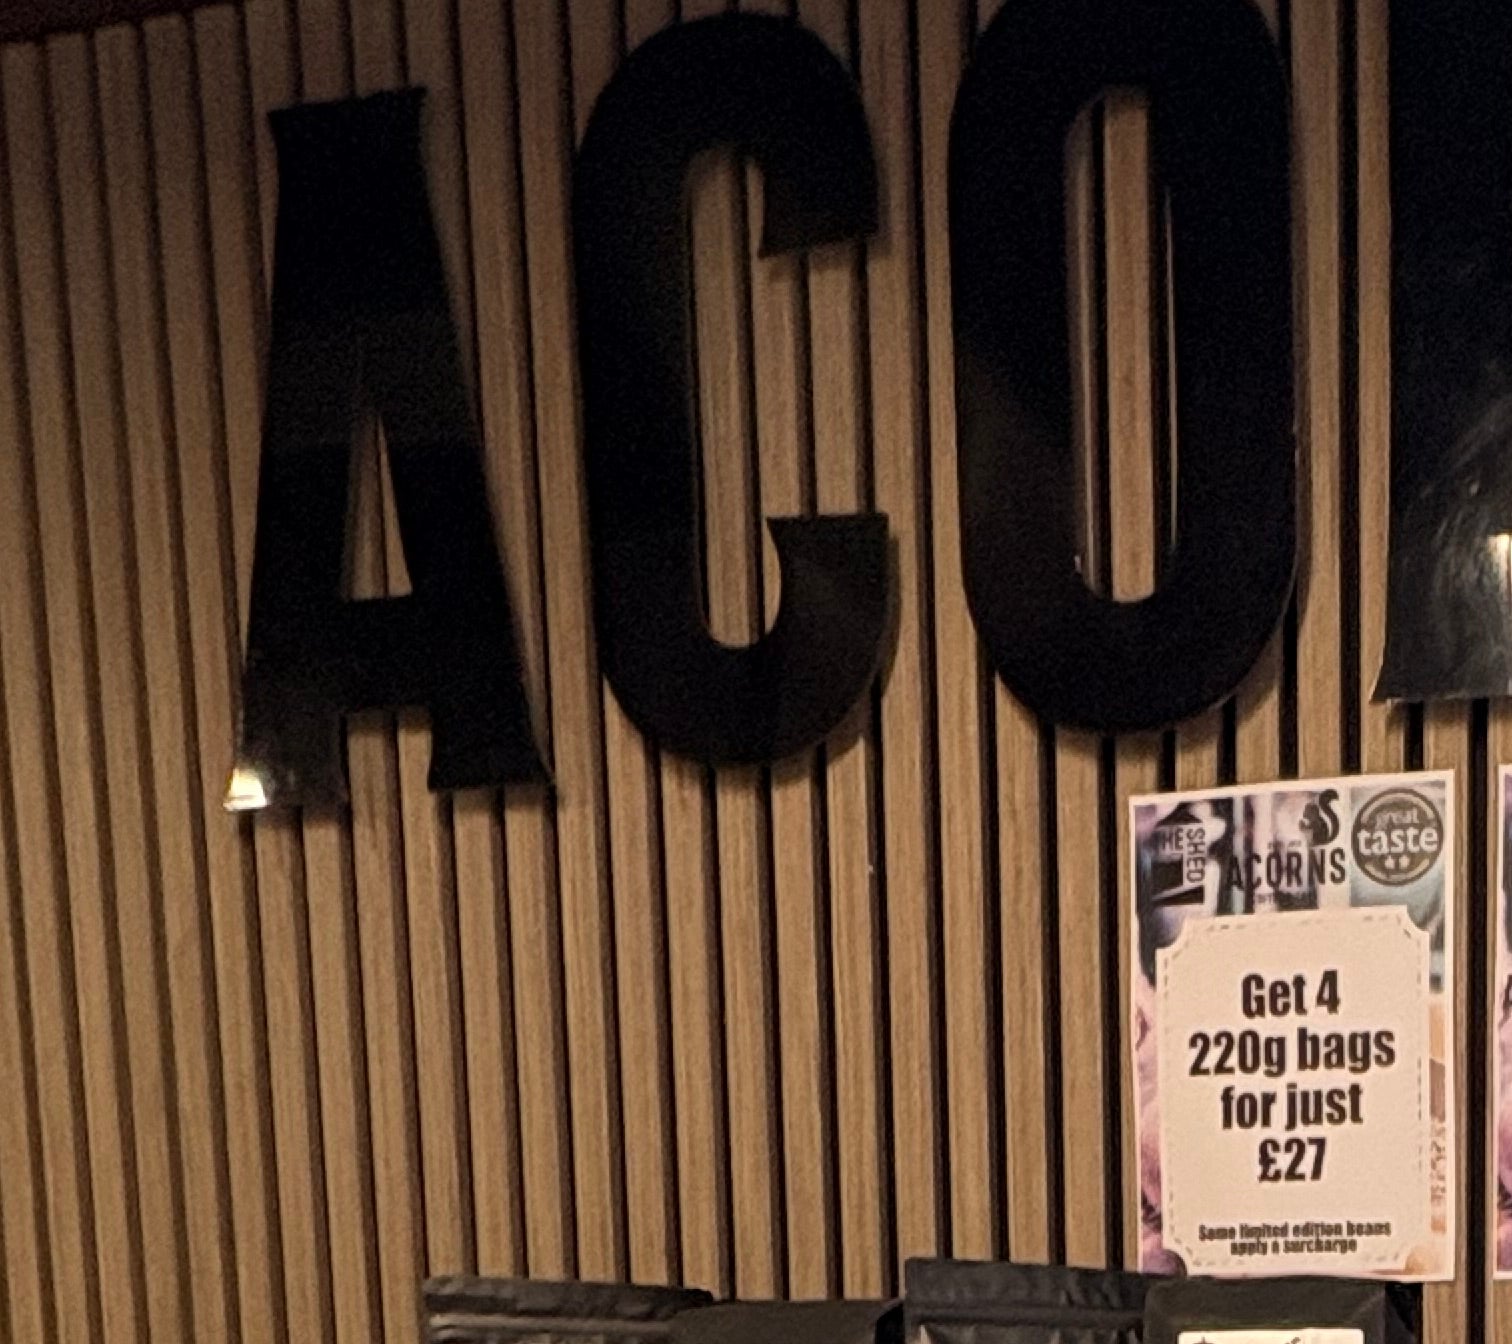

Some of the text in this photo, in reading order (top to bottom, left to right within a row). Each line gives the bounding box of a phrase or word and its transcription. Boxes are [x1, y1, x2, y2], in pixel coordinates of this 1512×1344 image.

[1186, 828, 1206, 883] SHED
[1357, 823, 1439, 856] taste
[1227, 848, 1346, 891] ACORNS
[1242, 969, 1340, 1018] Get 4
[1188, 1027, 1396, 1078] 220g bags
[1221, 1083, 1363, 1131] for just
[1258, 1137, 1327, 1182] £27
[1199, 1224, 1235, 1241] Some
[1239, 1223, 1288, 1238] limited
[1293, 1222, 1342, 1237] edition
